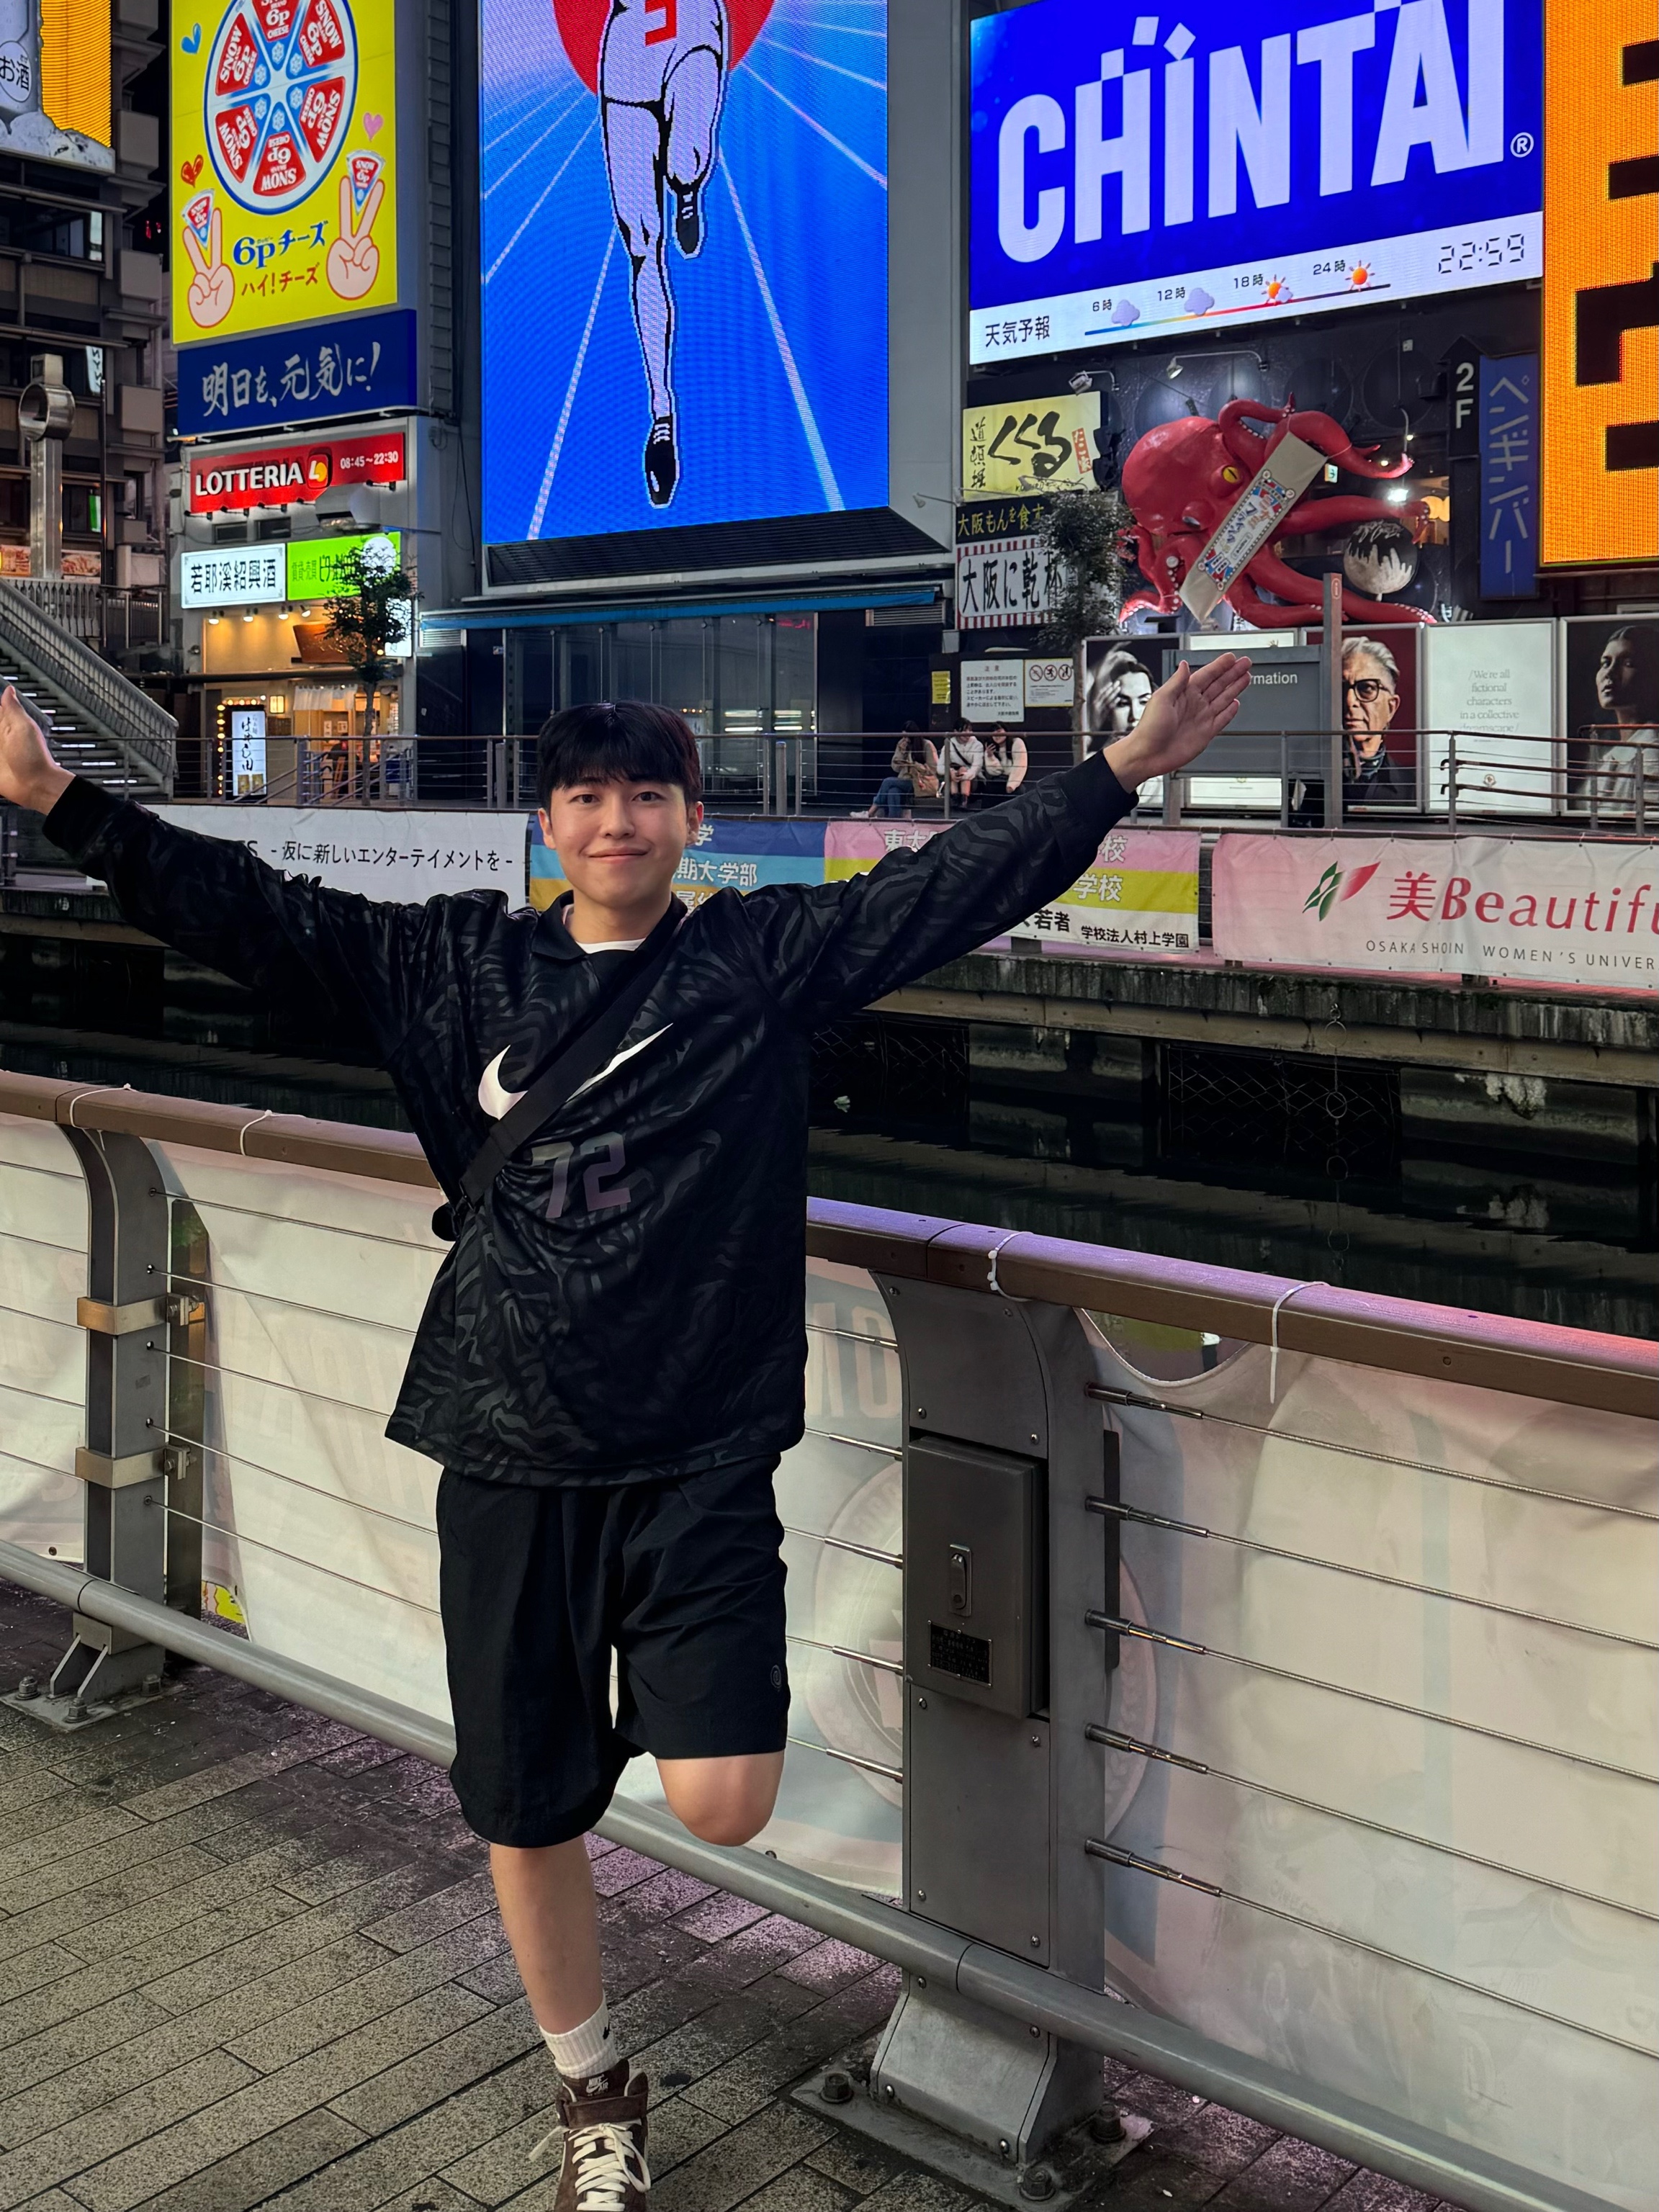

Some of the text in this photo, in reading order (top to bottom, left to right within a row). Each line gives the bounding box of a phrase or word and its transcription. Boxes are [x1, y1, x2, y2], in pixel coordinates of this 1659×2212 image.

[315, 1, 342, 48] SNOW
[220, 25, 243, 83] SNOW
[316, 90, 341, 150] SNOW
[998, 0, 1504, 264] CHINTAI
[218, 122, 243, 170] SNOW
[261, 168, 297, 192] SNOW
[1313, 259, 1346, 275] 24時
[1437, 233, 1525, 274] 22:59
[1157, 286, 1186, 302] 12時
[1233, 274, 1264, 289] 18時
[1092, 299, 1112, 313] 6時
[984, 315, 1051, 348] 天気予報
[988, 411, 1072, 478] くくる
[195, 462, 304, 496] LOTTERIA
[1472, 683, 1507, 693] fictional
[1500, 670, 1511, 679] all
[1460, 711, 1469, 719] in
[1477, 710, 1519, 719] collective
[1467, 696, 1512, 706] characters
[884, 829, 938, 852] 東大
[1073, 873, 1123, 902] 学校
[1387, 871, 1659, 935] 美Beautif
[1081, 925, 1190, 948] 学校法人村上学園
[1366, 940, 1416, 954] OSAKA
[1422, 942, 1464, 955] SHOIN
[1586, 954, 1659, 971] UNIVER
[531, 1131, 631, 1219] 72
